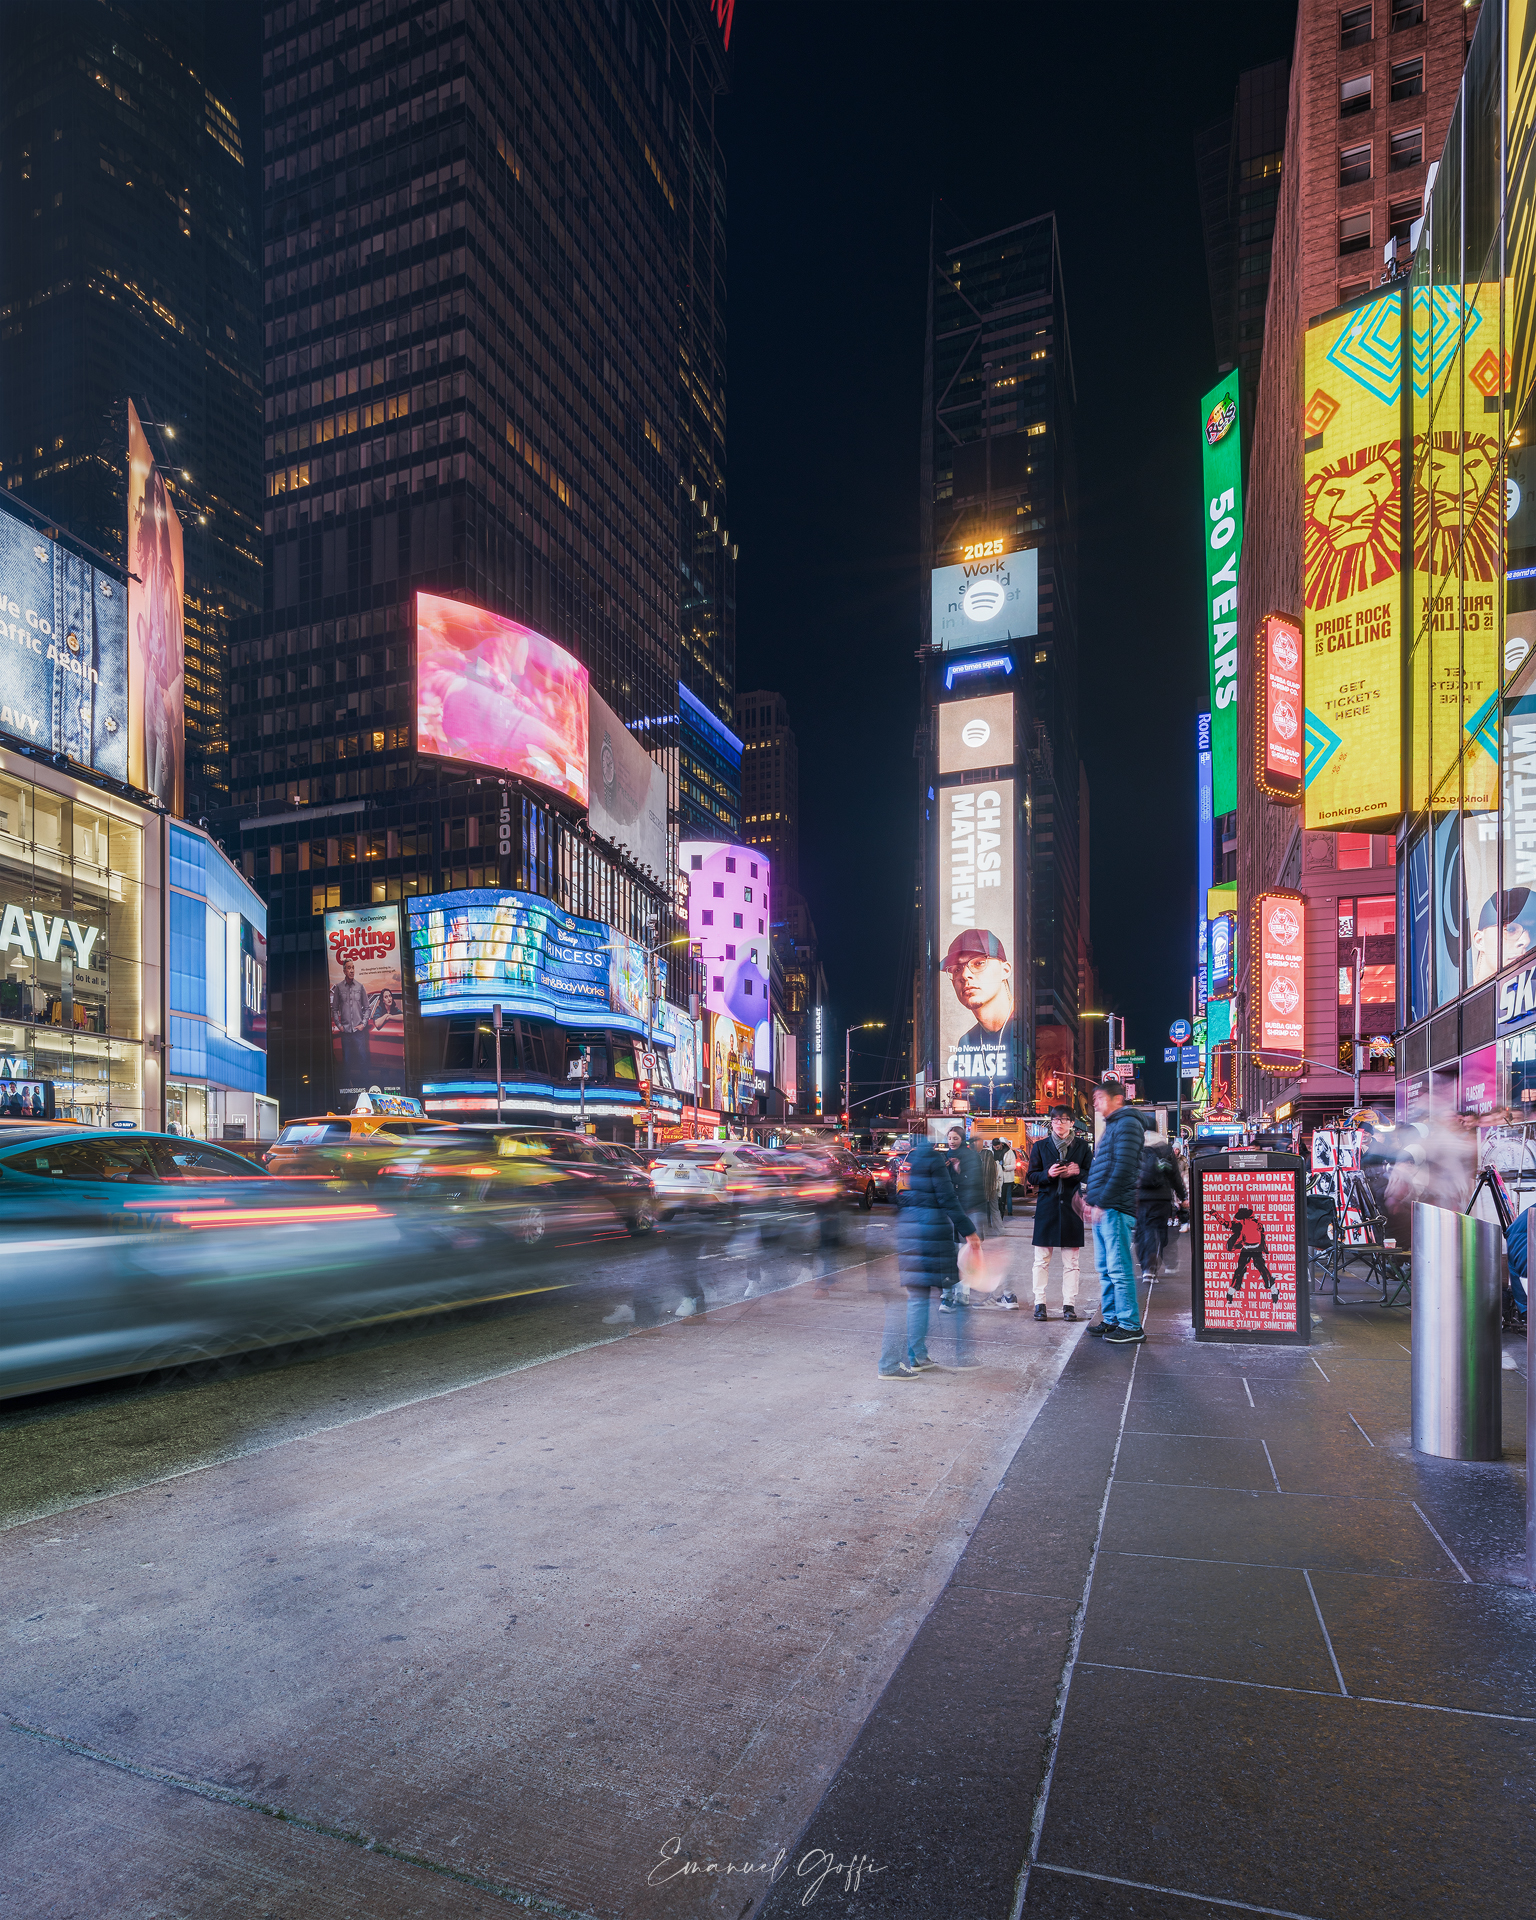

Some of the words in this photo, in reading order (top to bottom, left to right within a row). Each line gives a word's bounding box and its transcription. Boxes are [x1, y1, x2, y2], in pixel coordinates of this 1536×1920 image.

[1209, 486, 1234, 550] 50
[964, 538, 1004, 561] 2025
[963, 559, 1005, 578] Work
[25, 609, 55, 640] Go.
[1315, 614, 1352, 638] PRIDE
[1355, 602, 1391, 626] ROCK
[1211, 552, 1238, 710] YEARS
[1315, 642, 1324, 653] IS
[1327, 620, 1391, 653] CALLING
[46, 643, 104, 687] Again.
[1339, 679, 1366, 694] GET
[1325, 689, 1381, 710] TICKETS
[1335, 705, 1371, 721] HERE
[1318, 800, 1388, 820] lionking.com
[499, 792, 511, 856] 1500
[977, 790, 1001, 888] CHASE
[952, 793, 975, 927] MATTHEW
[0, 904, 99, 970] AVY
[329, 925, 396, 951] Shifting
[557, 928, 578, 946] Disney
[335, 945, 387, 965] Gears
[1265, 952, 1285, 960] BUBBA
[1285, 954, 1302, 962] GUMP
[1267, 959, 1290, 967] SHRIMP
[245, 952, 263, 1014] GAP
[1265, 1022, 1285, 1030] BUBBA
[980, 1044, 1006, 1052] Album
[947, 1053, 1007, 1078] CHASE
[1203, 1174, 1222, 1182] JAM
[1256, 1173, 1294, 1181] MONEY
[1203, 1183, 1243, 1192] SMOOTH
[1246, 1183, 1294, 1191] CRIMINAL
[1203, 1194, 1221, 1202] BILLIE
[1223, 1194, 1239, 1202] JEAN
[1250, 1194, 1265, 1202] WANT
[1267, 1194, 1278, 1202] YOU
[1280, 1194, 1294, 1202] BACK
[1254, 1213, 1279, 1222] FEEL
[1284, 1213, 1294, 1222] IT
[1204, 1224, 1220, 1232] THEY
[1285, 1224, 1294, 1232] US
[1265, 1234, 1294, 1242] CHINE
[1204, 1243, 1223, 1251] MAN
[1204, 1252, 1219, 1260] DON'T
[1220, 1252, 1235, 1260] STOP
[1273, 1254, 1295, 1262] ENOUGH
[1204, 1262, 1217, 1270] KEEP
[1218, 1262, 1229, 1270] THE
[1204, 1271, 1235, 1279] BEAT
[1248, 1291, 1256, 1299] IN
[1260, 1291, 1295, 1300] MOCOW
[1204, 1300, 1224, 1308] TABLOID
[1248, 1301, 1258, 1309] THE
[1283, 1302, 1296, 1310] SAVE
[1204, 1309, 1240, 1317] THRILLER
[1245, 1310, 1258, 1318] I'LL
[1260, 1311, 1270, 1319] BE
[1271, 1311, 1296, 1320] THERE
[1204, 1318, 1226, 1327] WANNA
[1227, 1319, 1235, 1327] BE
[1236, 1320, 1262, 1328] STARTIN'
[1264, 1321, 1296, 1330] SOMETHIN'
